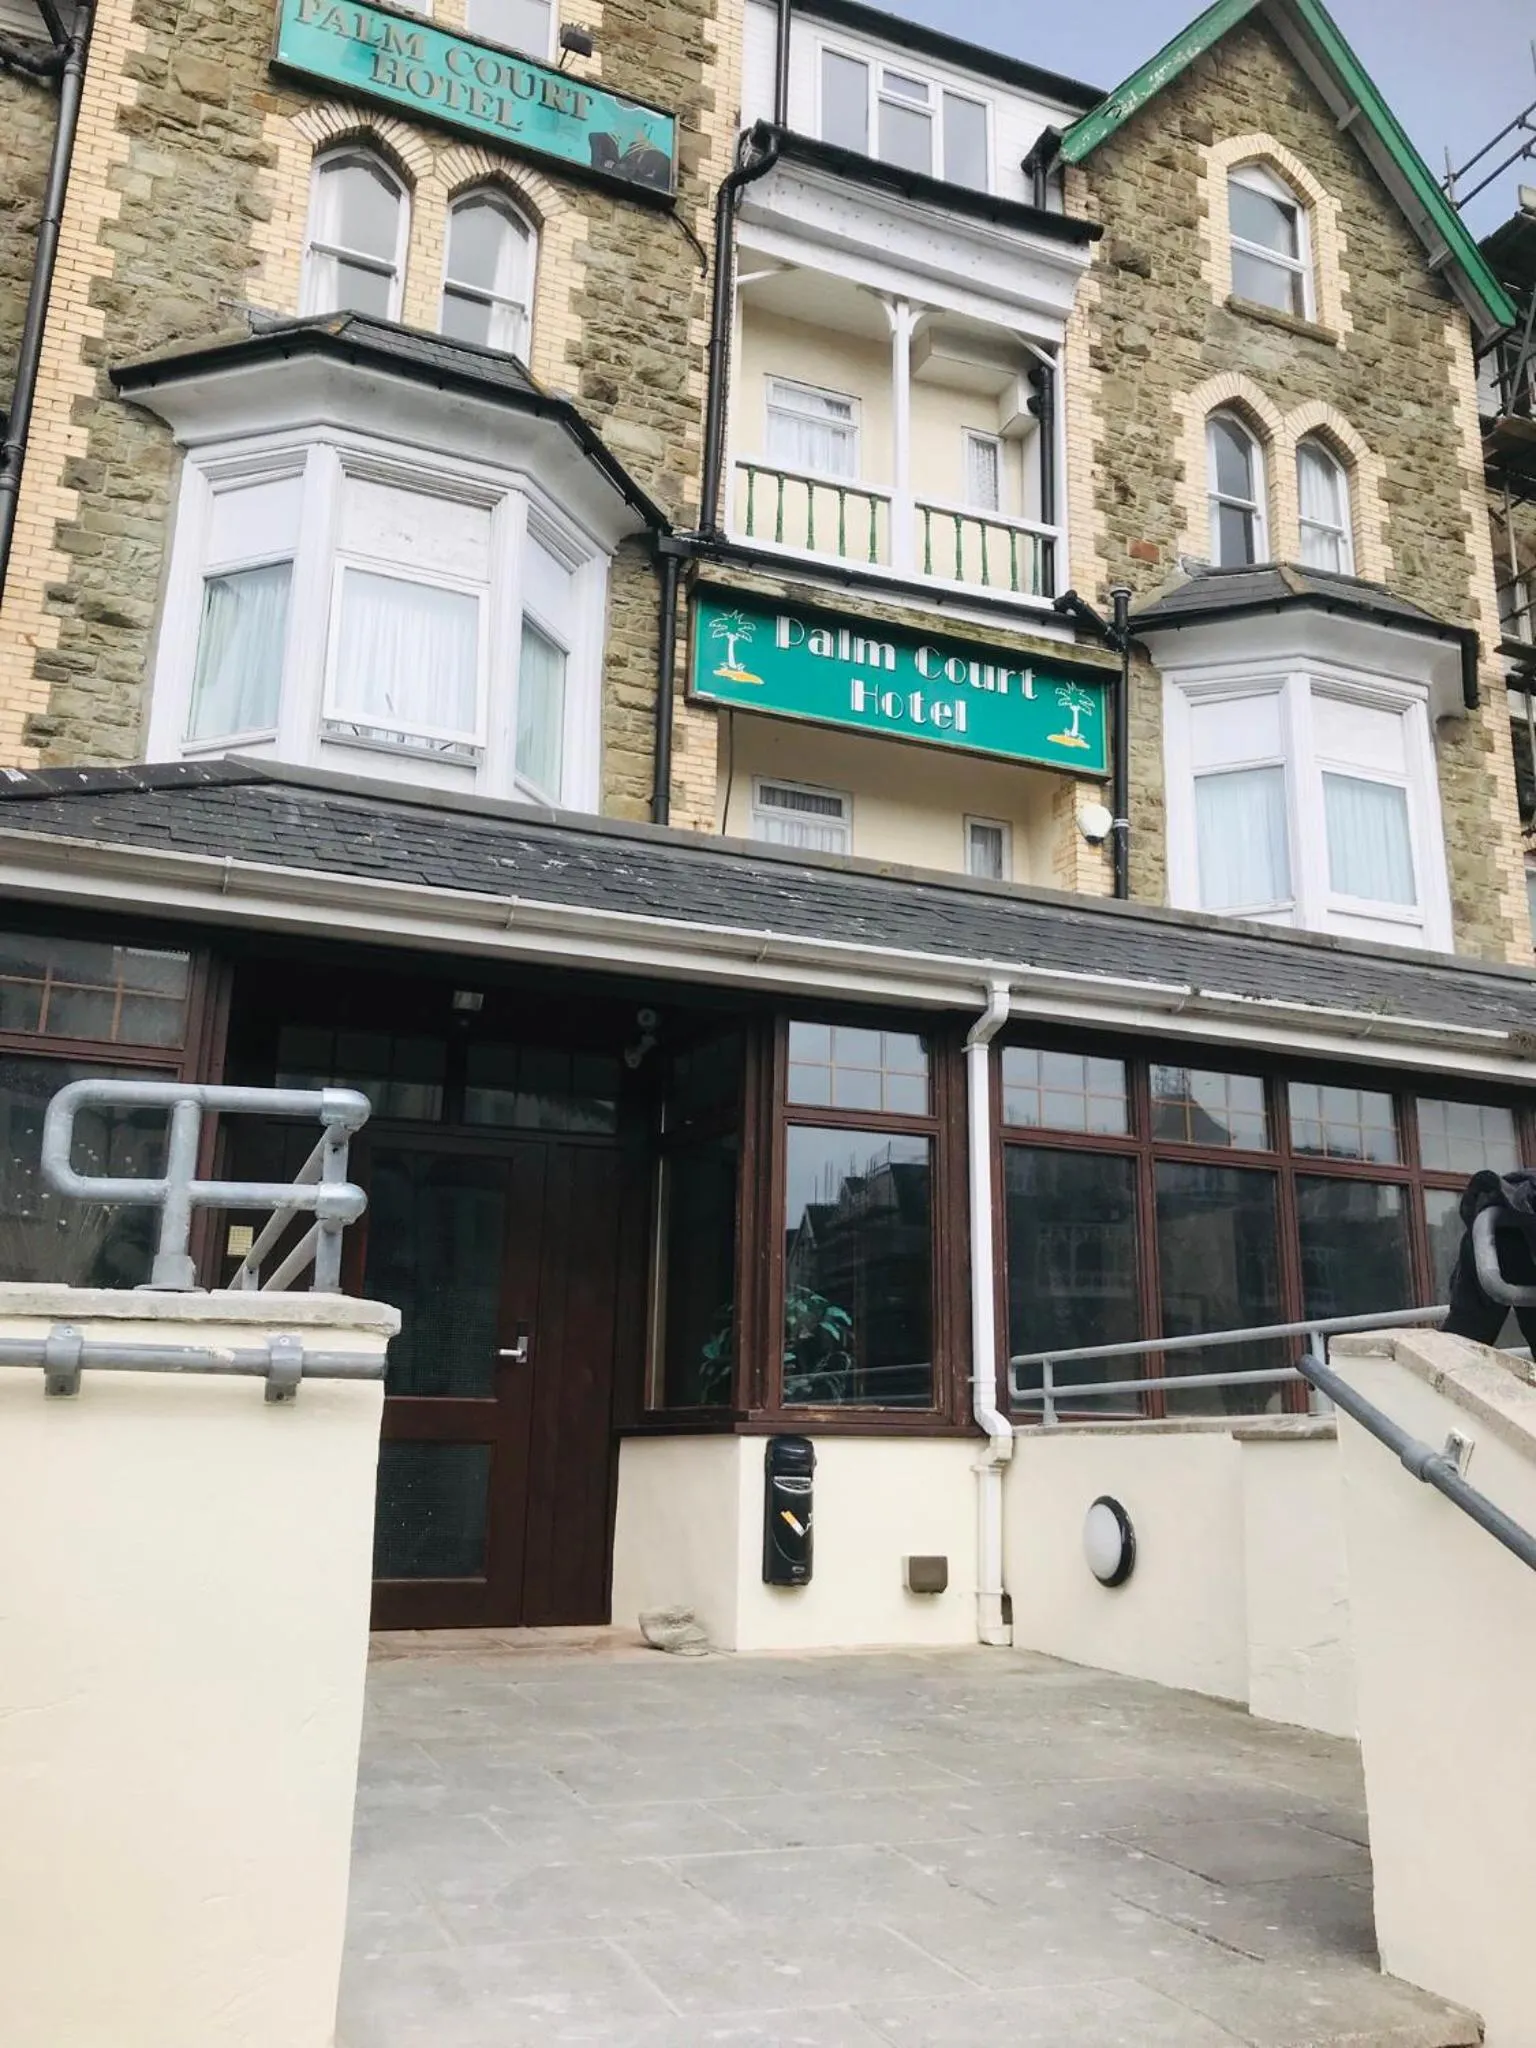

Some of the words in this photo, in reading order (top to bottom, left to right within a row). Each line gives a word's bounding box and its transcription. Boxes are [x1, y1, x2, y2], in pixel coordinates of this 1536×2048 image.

[294, 0, 425, 62] PALM
[445, 46, 593, 121] COURT
[369, 52, 523, 131] HOTEL
[775, 615, 897, 672] Palm
[914, 645, 1038, 700] Court
[851, 678, 967, 732] Hotel
